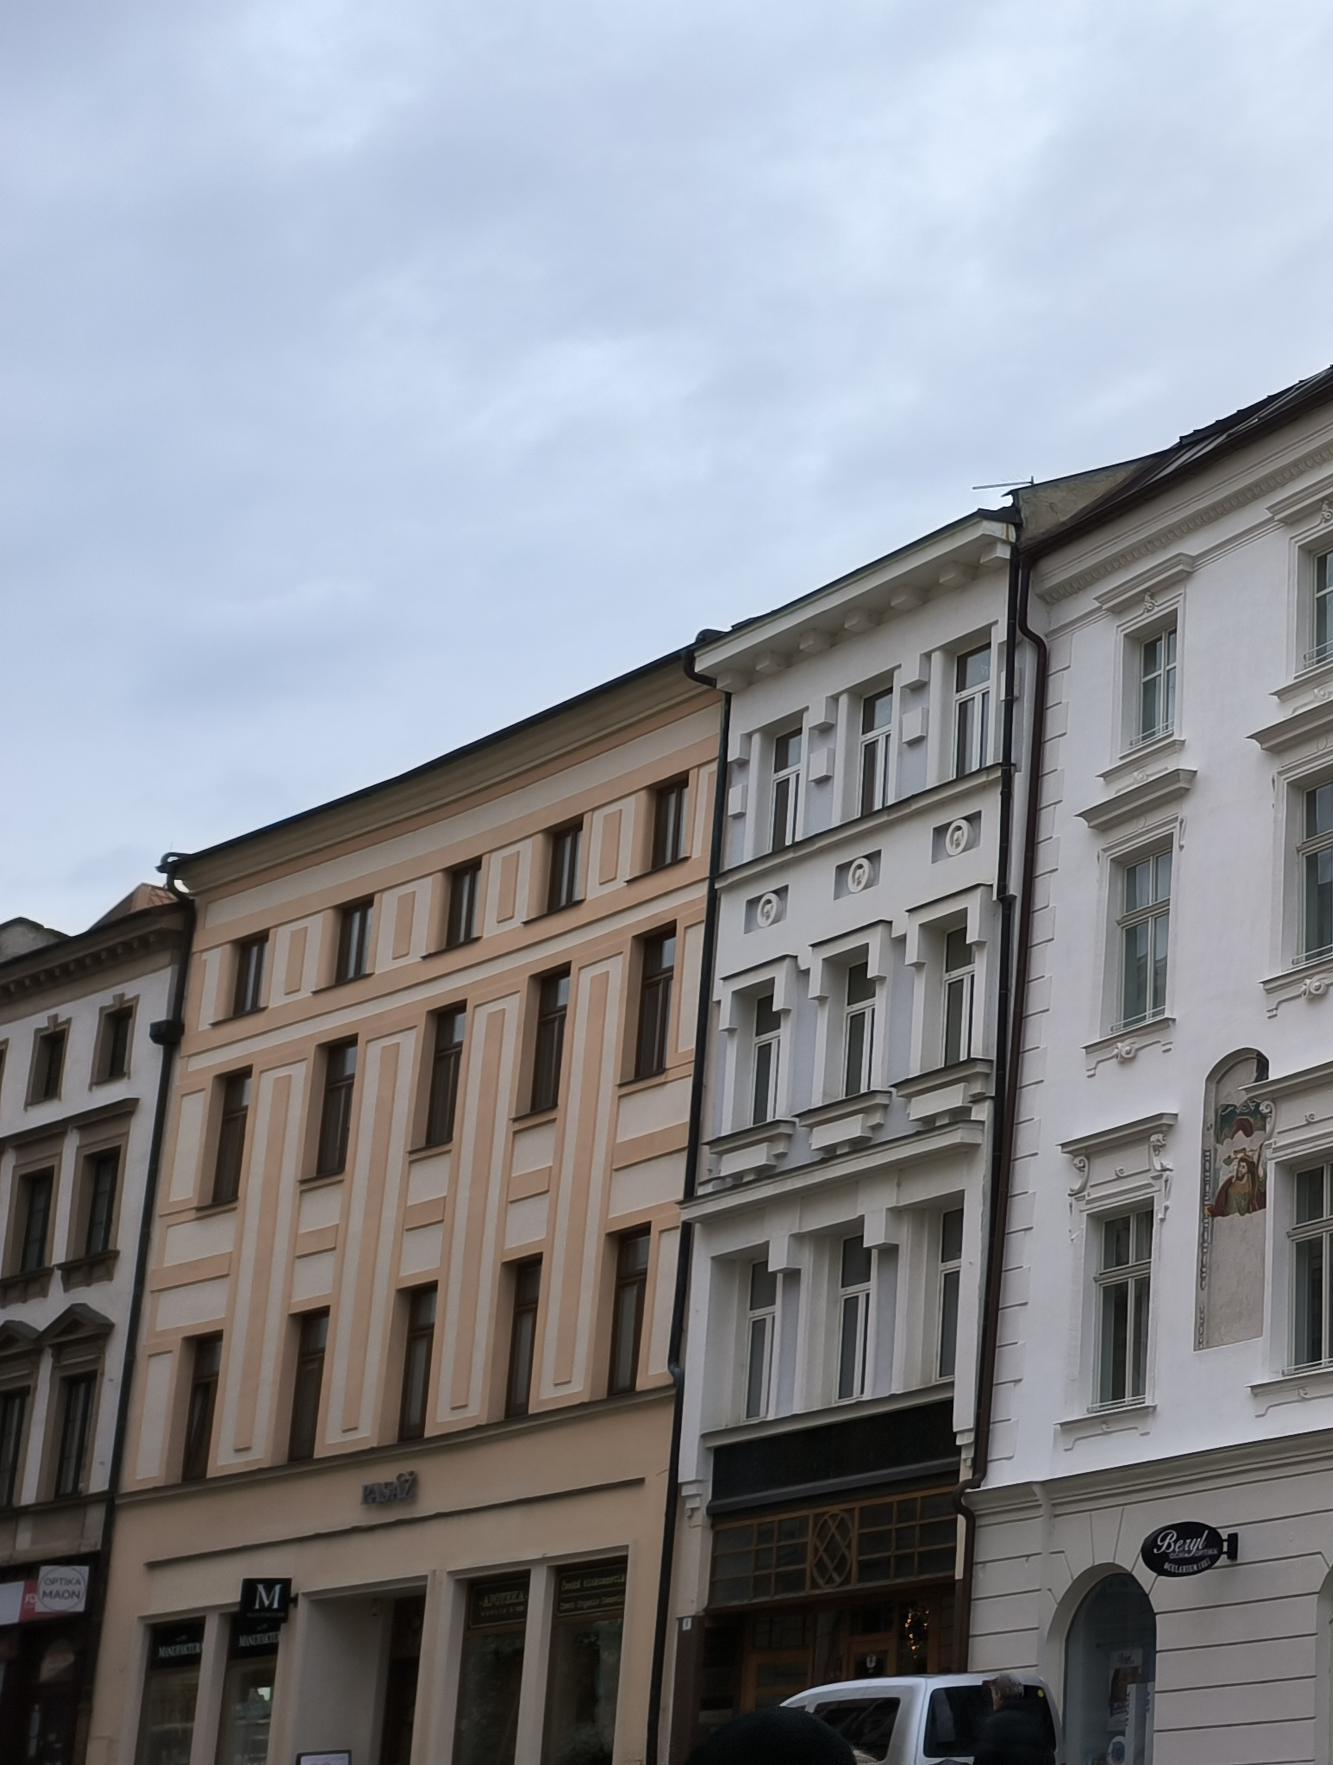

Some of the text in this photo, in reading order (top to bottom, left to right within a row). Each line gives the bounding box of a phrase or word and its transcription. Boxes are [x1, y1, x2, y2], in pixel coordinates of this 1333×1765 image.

[1153, 1529, 1209, 1557] Beryl
[43, 1577, 81, 1586] OPTIKA
[42, 1589, 81, 1601] MAON
[253, 1583, 283, 1609] M
